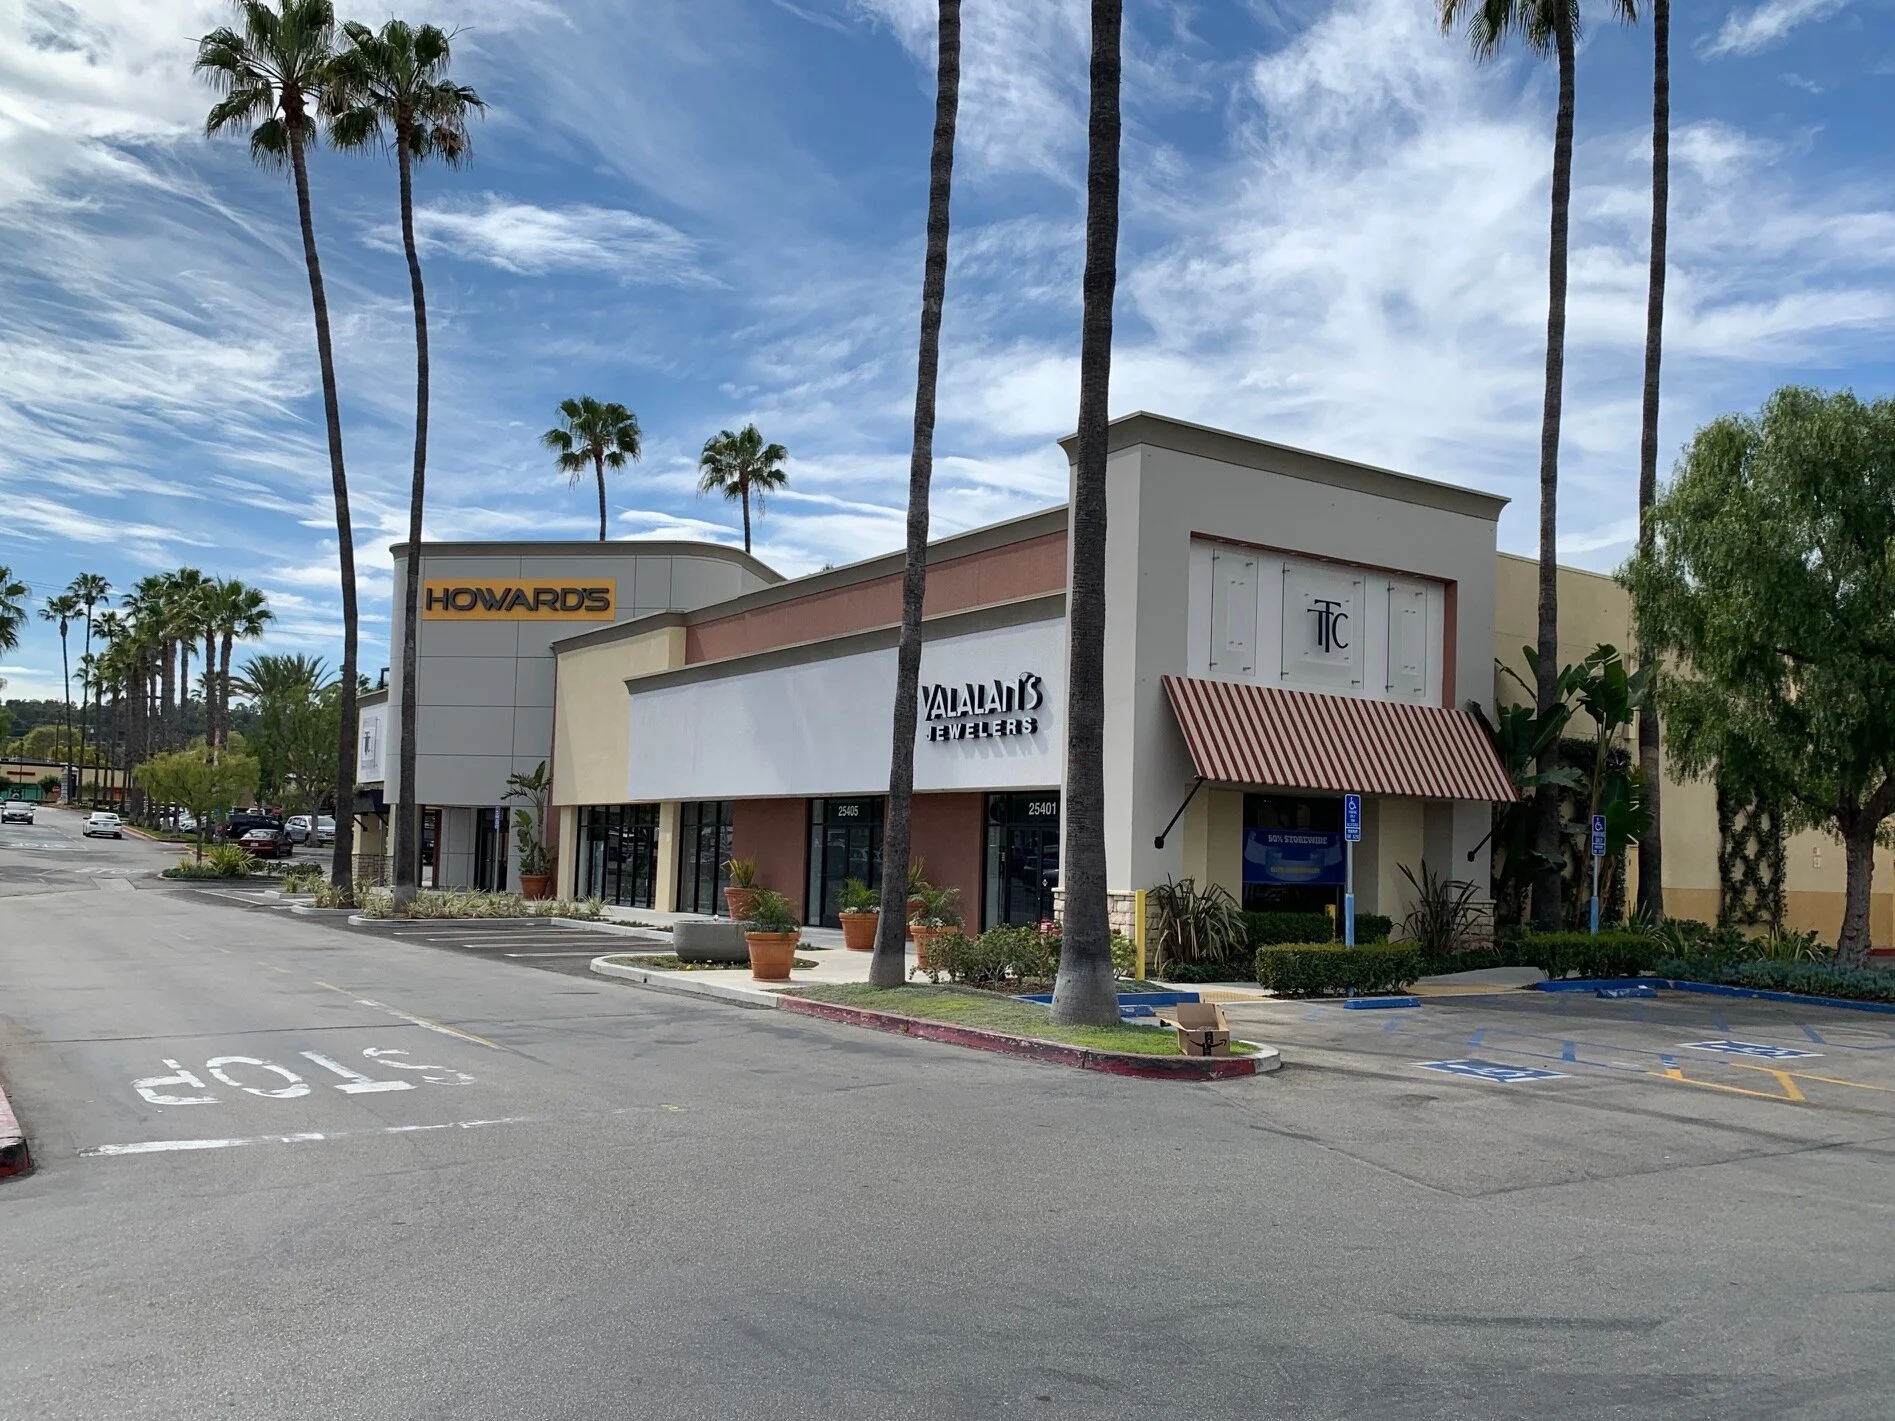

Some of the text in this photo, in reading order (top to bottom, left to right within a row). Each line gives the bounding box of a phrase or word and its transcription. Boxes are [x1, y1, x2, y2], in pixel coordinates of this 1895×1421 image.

[426, 587, 610, 612] HOWARD'S
[926, 717, 1038, 741] JEWELERS
[838, 805, 859, 818] 25405
[1028, 801, 1057, 816] 25401
[1284, 835, 1328, 845] STOREWIDE
[132, 1047, 477, 1105] STOP
